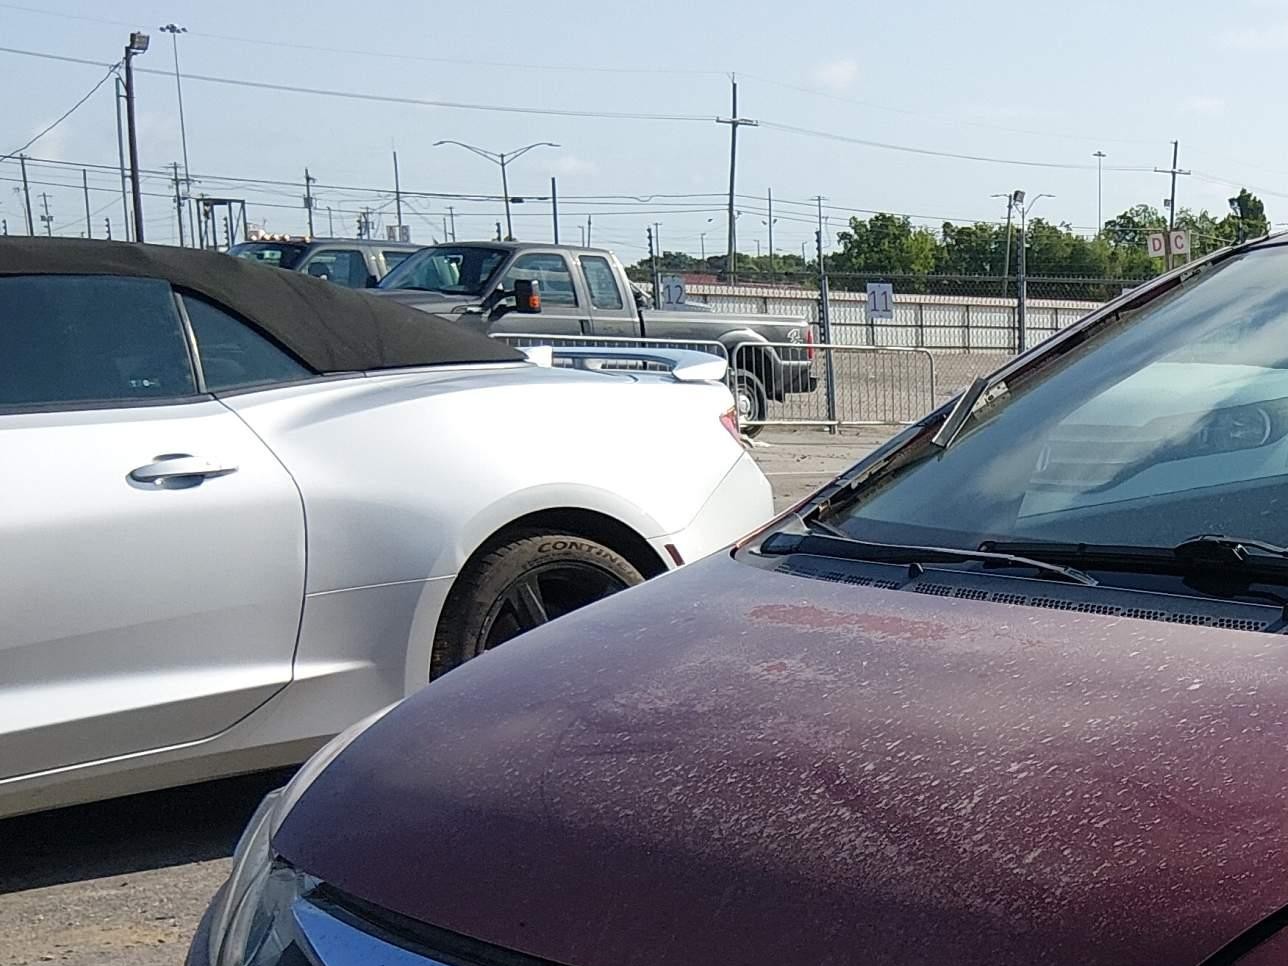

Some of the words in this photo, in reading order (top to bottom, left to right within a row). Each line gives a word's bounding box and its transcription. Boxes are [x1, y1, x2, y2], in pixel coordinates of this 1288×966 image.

[1151, 237, 1162, 252] D
[1174, 234, 1184, 250] C
[664, 284, 684, 305] 12
[870, 291, 891, 313] 11
